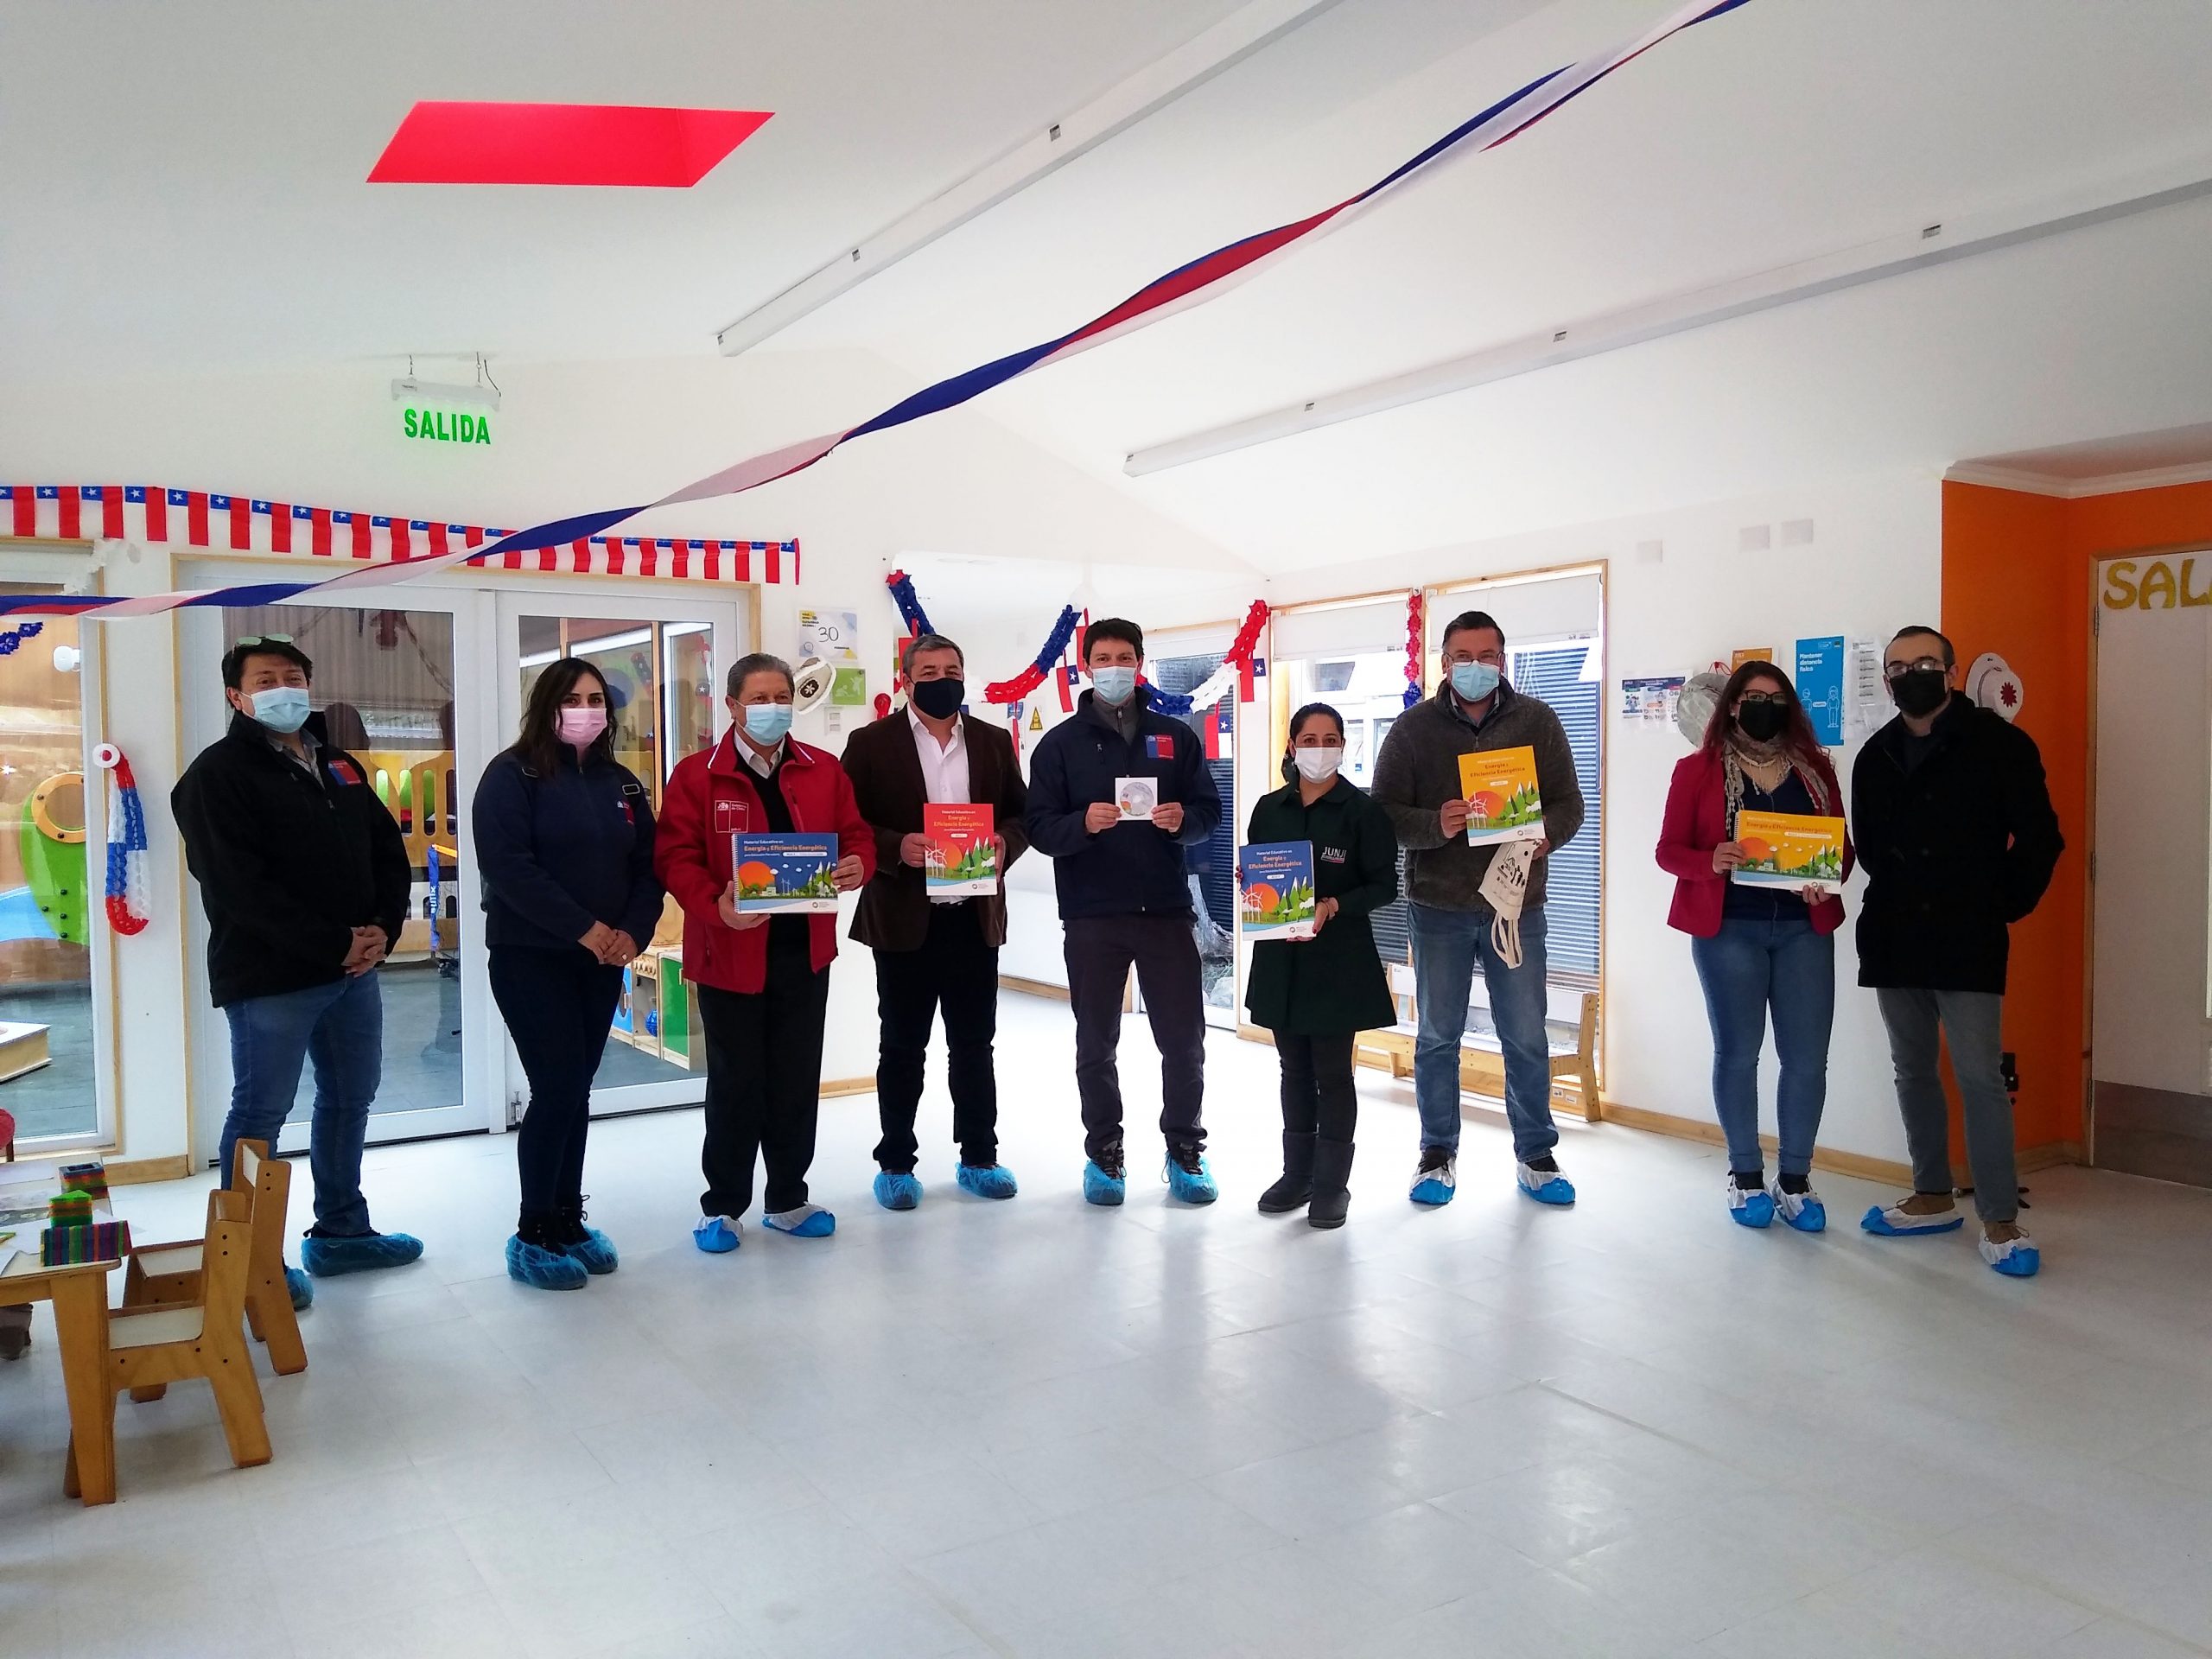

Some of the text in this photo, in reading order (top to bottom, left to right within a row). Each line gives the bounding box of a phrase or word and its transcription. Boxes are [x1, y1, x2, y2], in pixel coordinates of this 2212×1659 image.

[404, 408, 491, 445] SALIDA
[2103, 558, 2212, 610] SAL
[818, 626, 839, 643] 30
